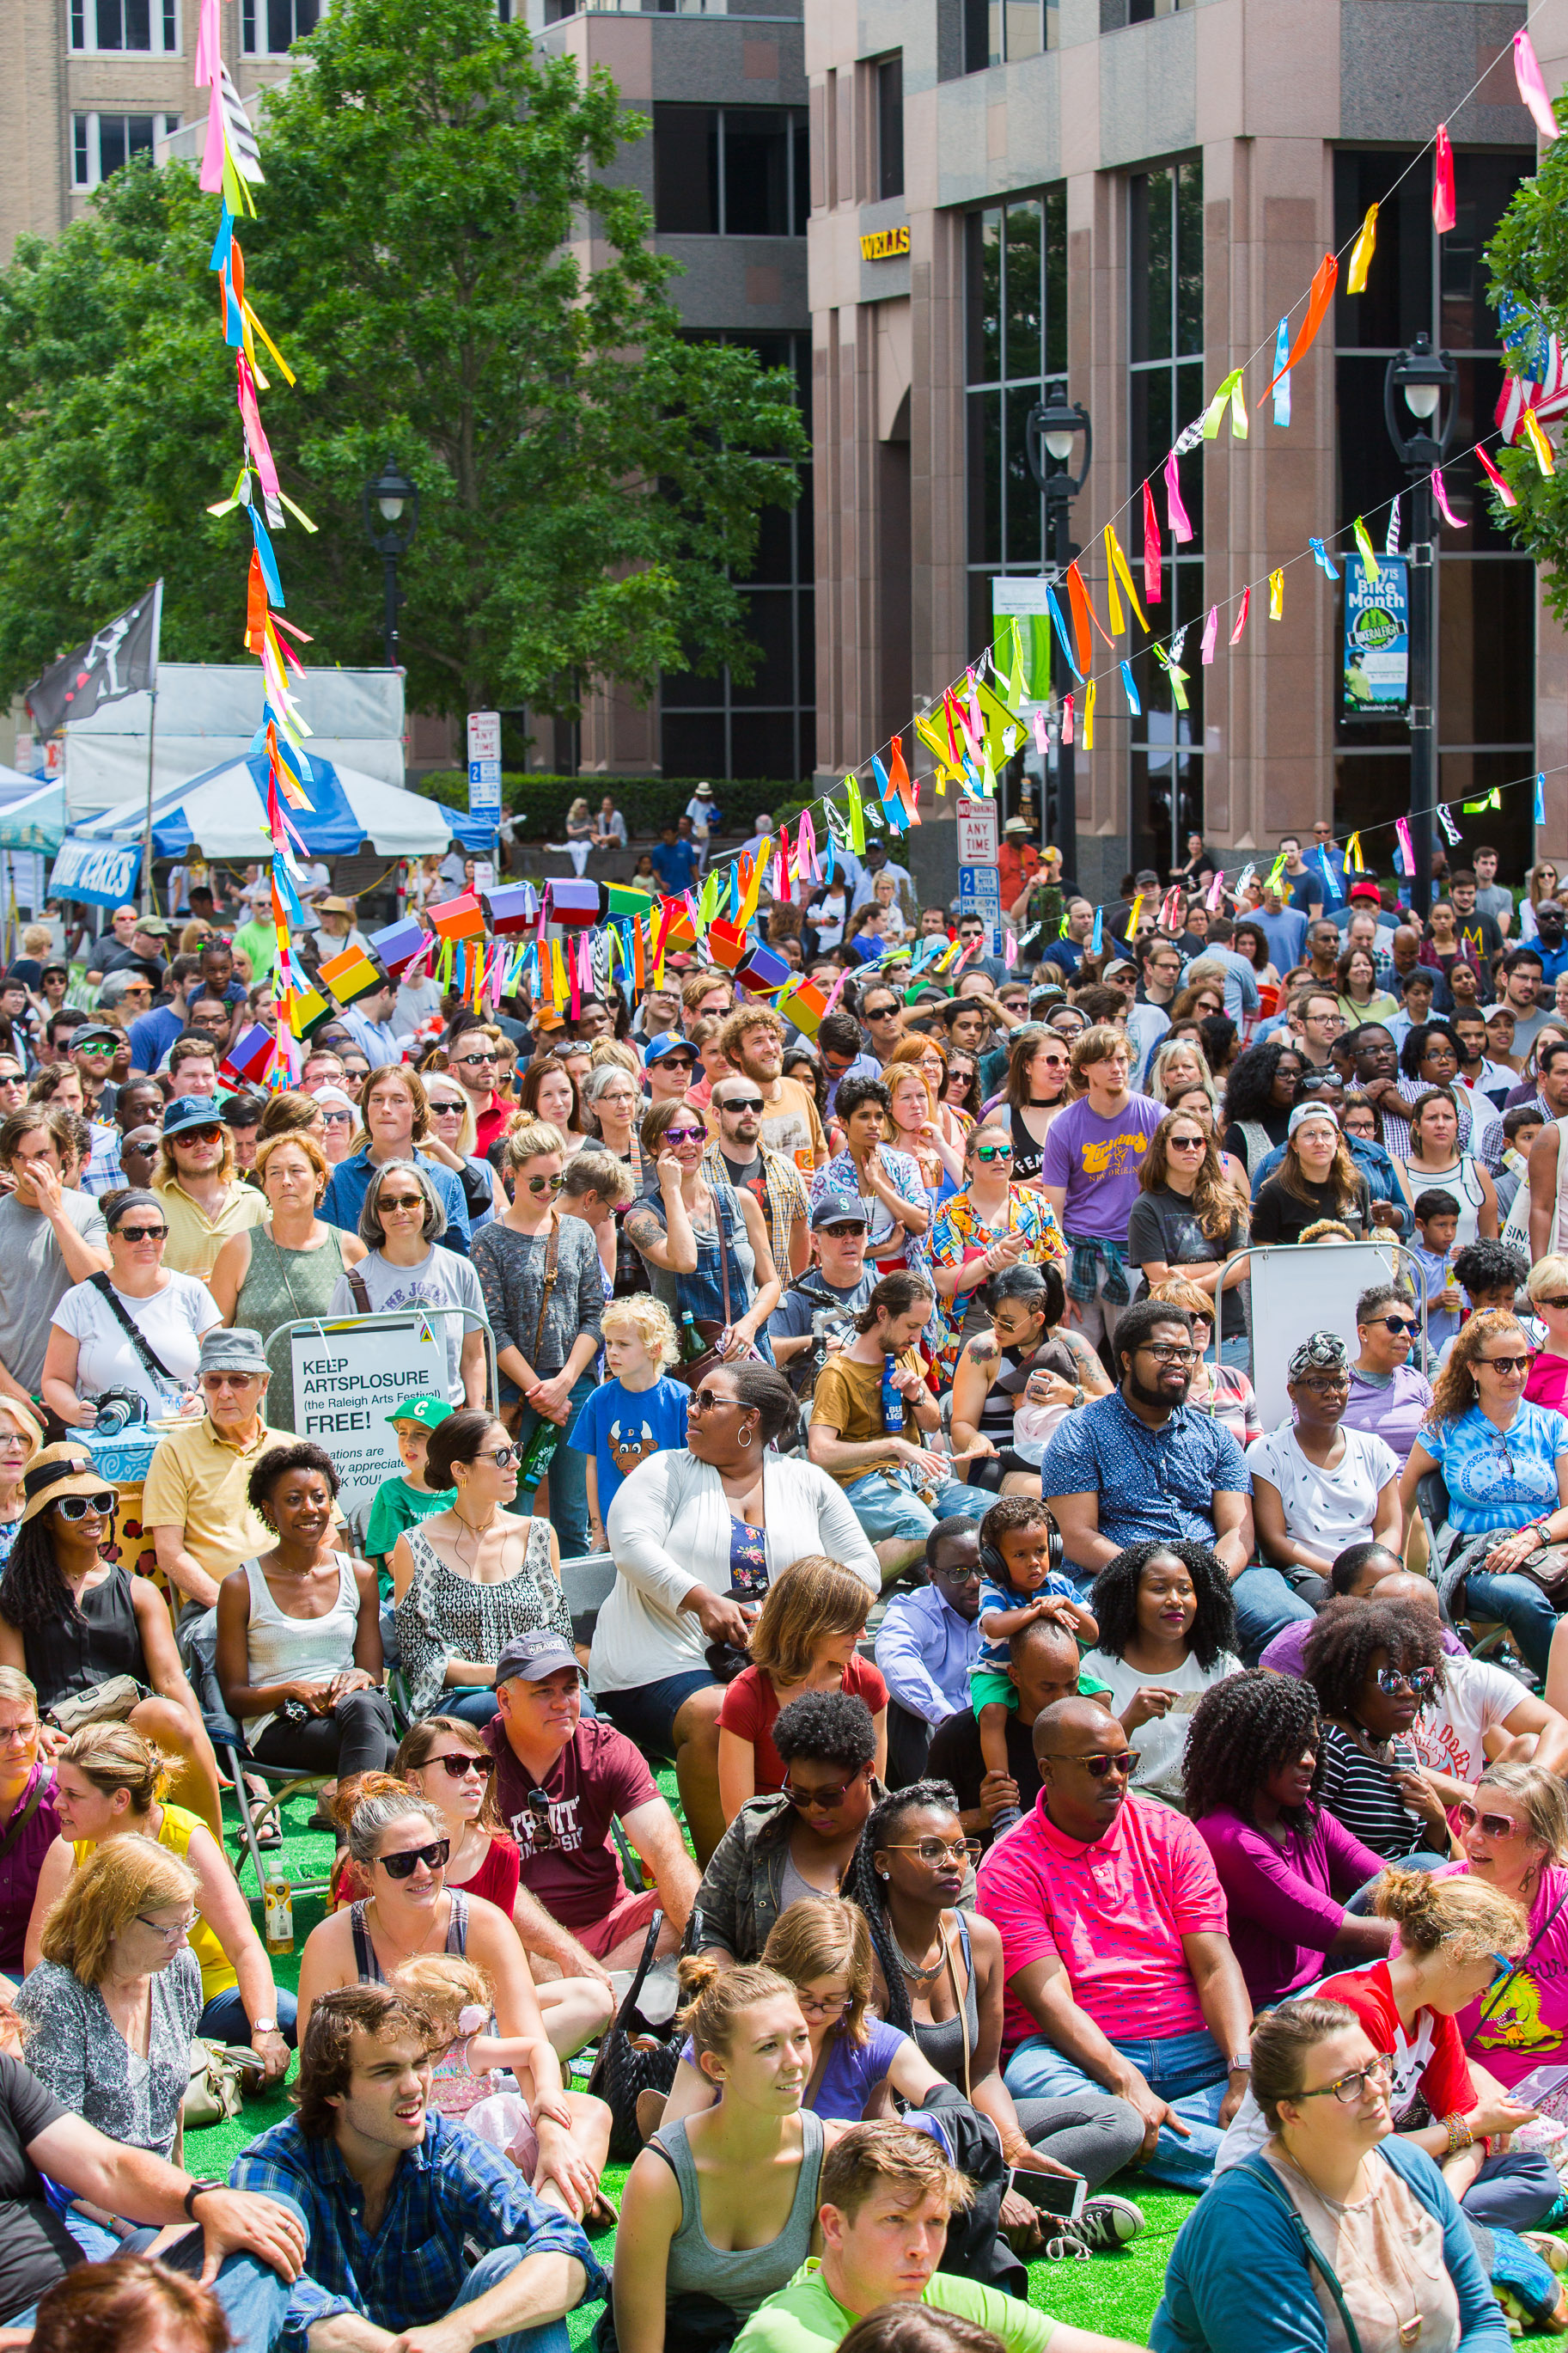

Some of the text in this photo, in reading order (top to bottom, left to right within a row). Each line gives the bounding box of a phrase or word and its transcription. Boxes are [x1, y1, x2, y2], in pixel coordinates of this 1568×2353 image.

[859, 226, 910, 261] WELLS
[1354, 564, 1389, 583] My
[1358, 579, 1396, 594] Bike
[1348, 592, 1405, 608] Month
[1355, 623, 1400, 644] BIKERALEIGH
[474, 743, 495, 752] TIME
[472, 766, 479, 781] 2
[958, 803, 969, 816] NO
[967, 823, 988, 835] ANY
[967, 839, 991, 851] TIME
[963, 872, 972, 892] 2
[1107, 1165, 1140, 1176] ORLEAN
[303, 1358, 349, 1376] KEEP
[303, 1370, 430, 1394] ARTSPLOSURE
[304, 1400, 325, 1412] (the
[328, 1395, 369, 1409] Raleigh
[371, 1392, 394, 1404] Arts
[413, 1400, 429, 1416] C
[306, 1411, 371, 1434] FREE!
[329, 1447, 384, 1460] ations are
[348, 1458, 406, 1473] appreciate
[353, 1474, 381, 1487] YOU!
